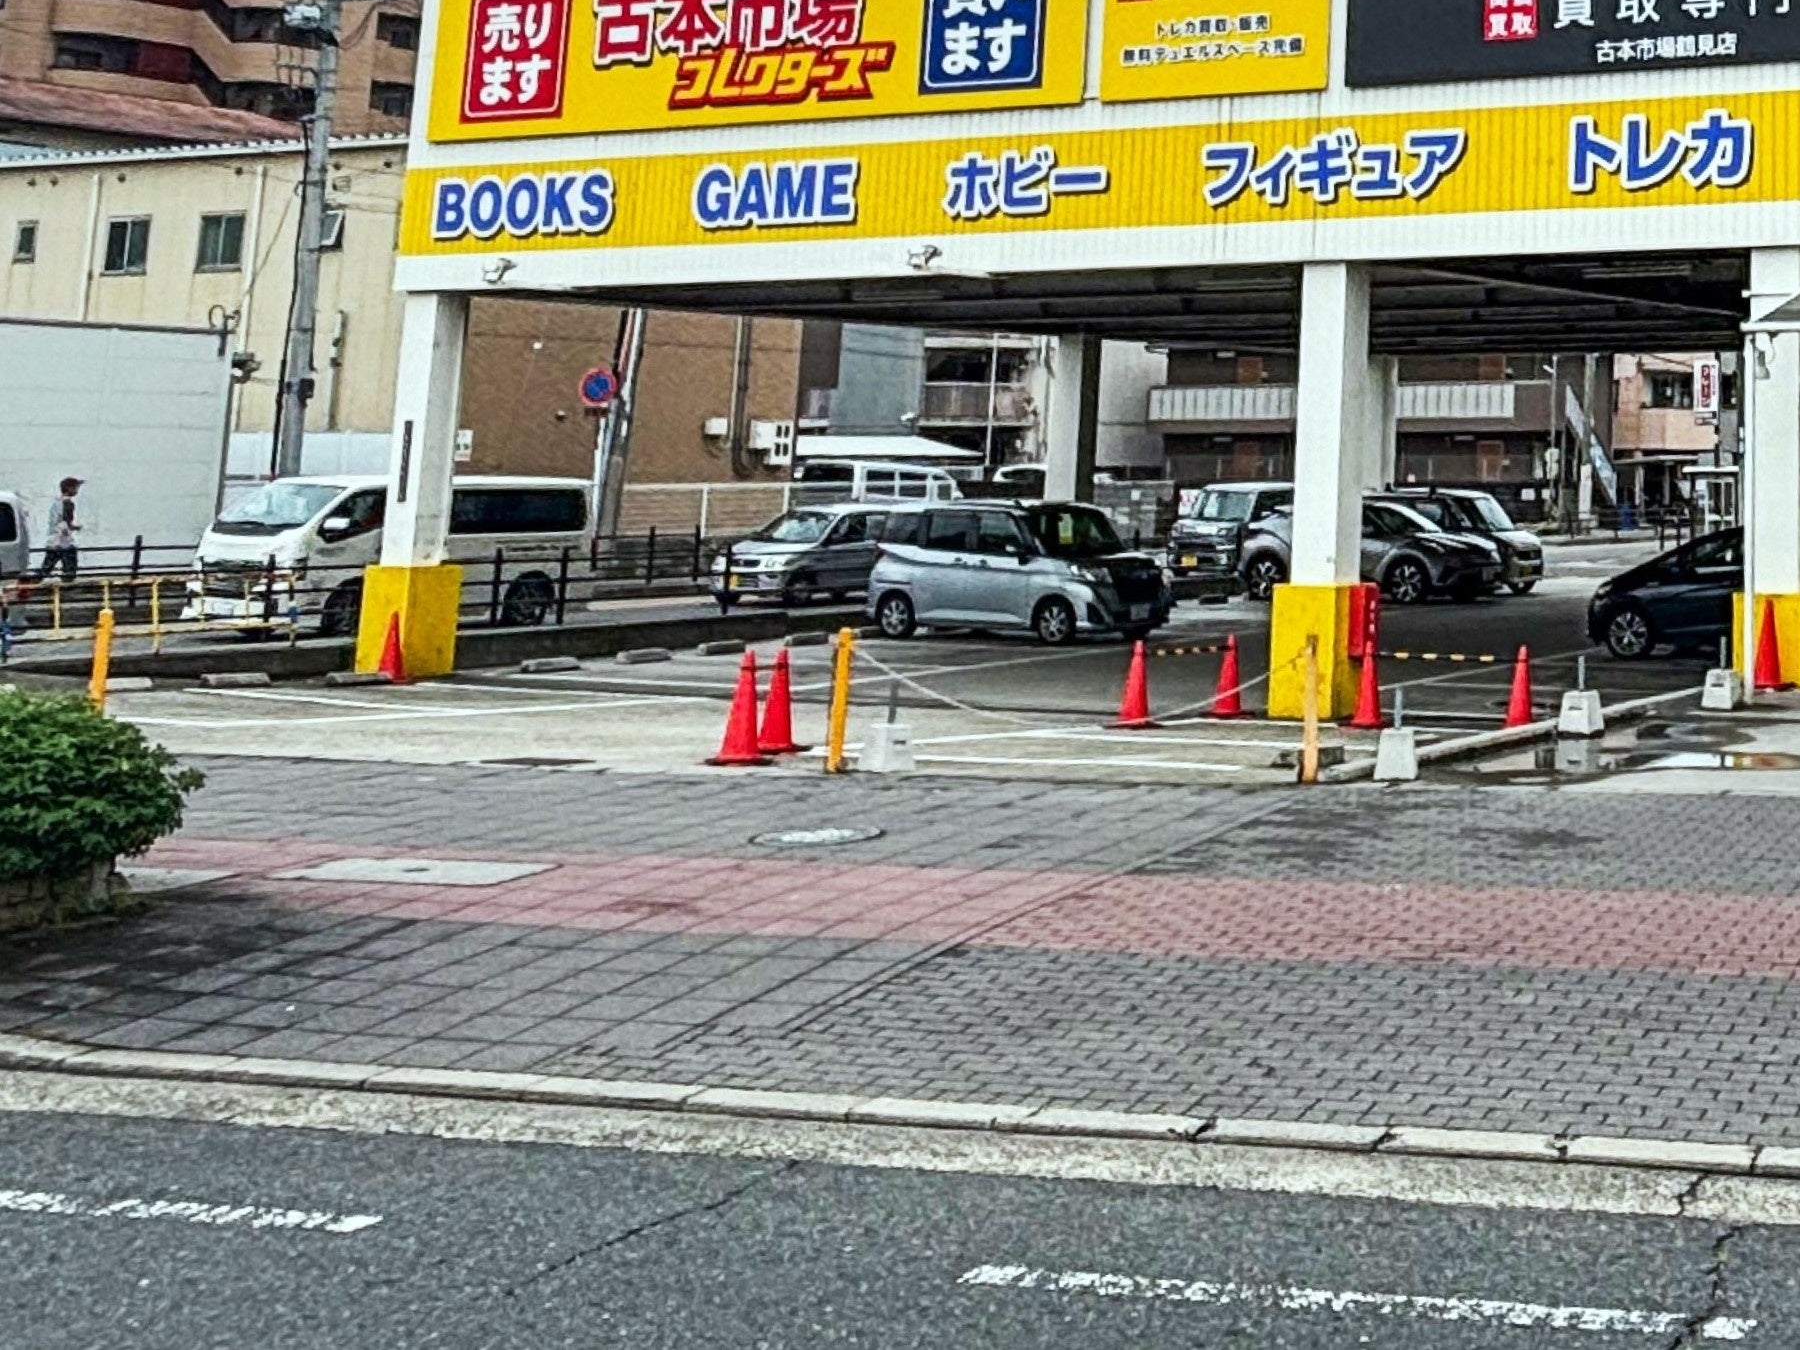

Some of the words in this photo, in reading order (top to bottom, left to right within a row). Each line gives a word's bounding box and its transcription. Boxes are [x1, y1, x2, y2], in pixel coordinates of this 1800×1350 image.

[481, 2, 552, 53] 売り
[941, 18, 1028, 75] ます
[1595, 32, 1738, 63] 古本市場鶴見店
[479, 54, 552, 105] ます
[669, 43, 894, 108] コレクターズ
[1203, 127, 1466, 205] フィギュア
[1568, 109, 1752, 191] トレカ
[434, 169, 613, 238] BOOKS
[694, 158, 860, 227] GAME
[944, 151, 1107, 219] ホビー
